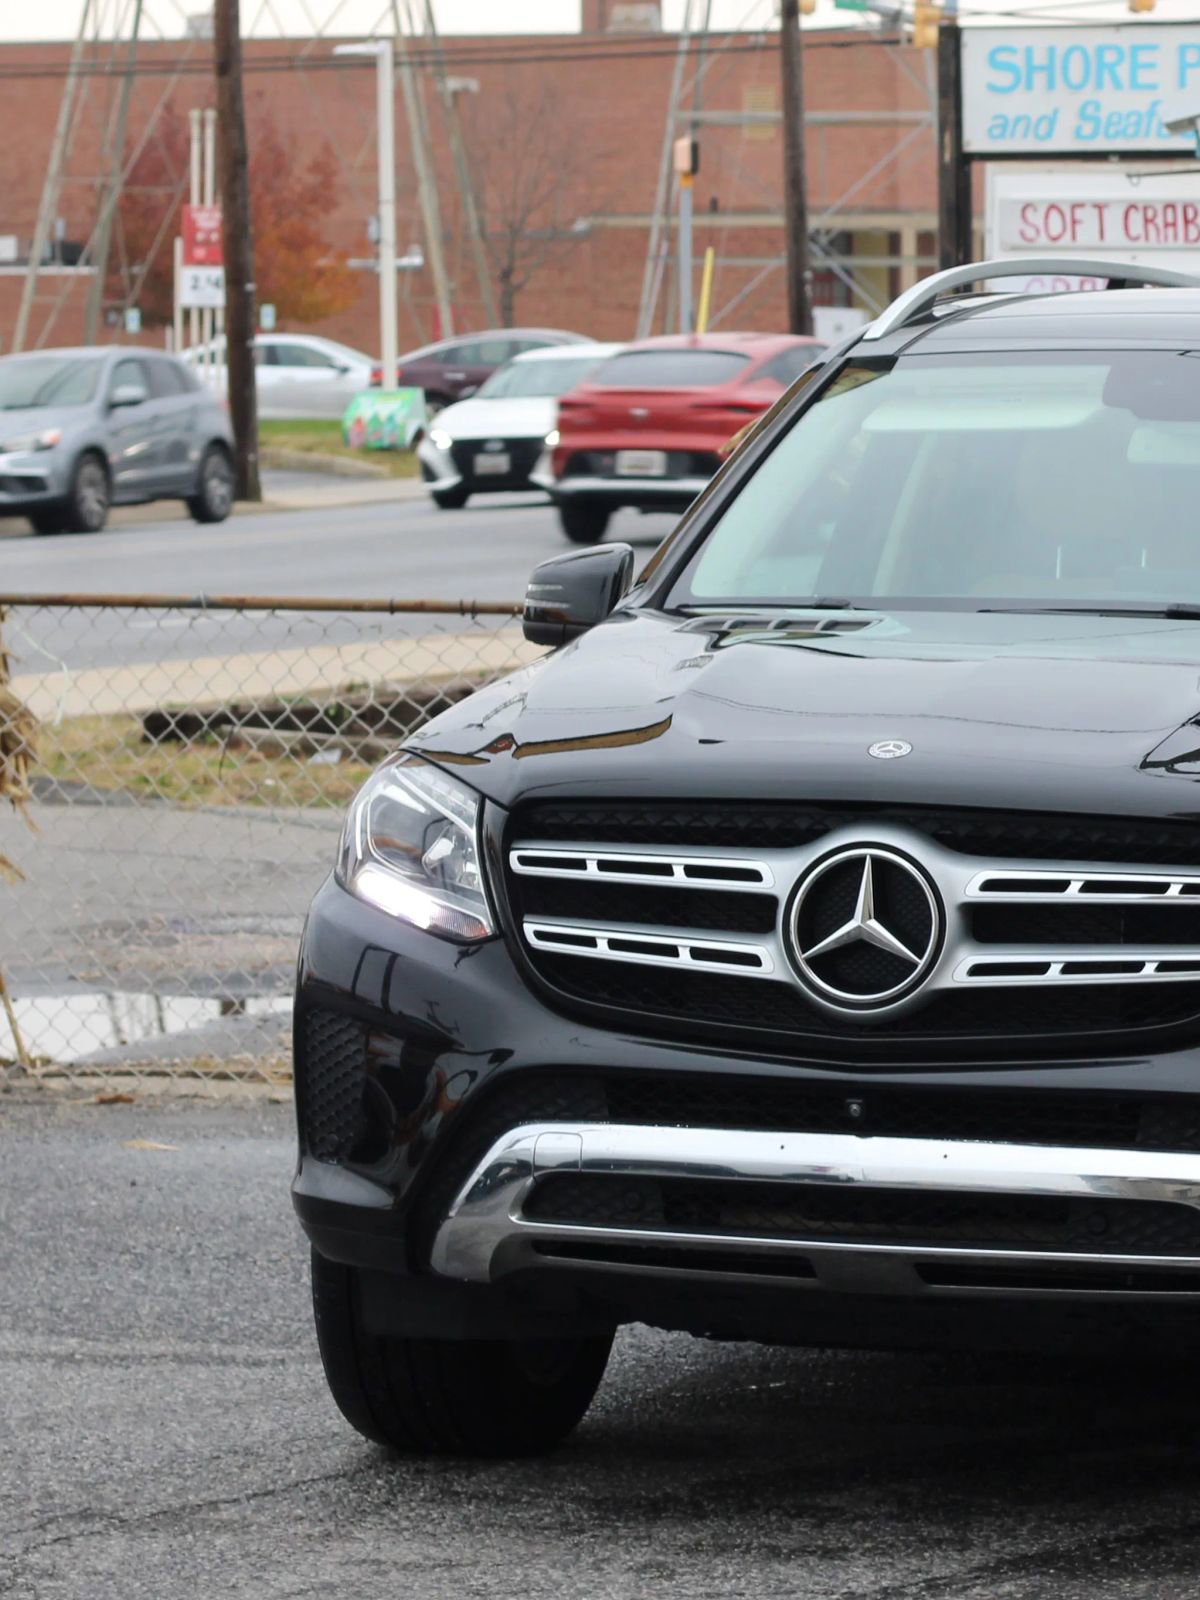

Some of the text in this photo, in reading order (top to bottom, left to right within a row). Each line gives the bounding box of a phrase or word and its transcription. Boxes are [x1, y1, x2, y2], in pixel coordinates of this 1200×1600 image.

[985, 44, 1160, 94] SHORE
[987, 99, 1196, 141] and Seaf
[1019, 203, 1109, 242] SOFT
